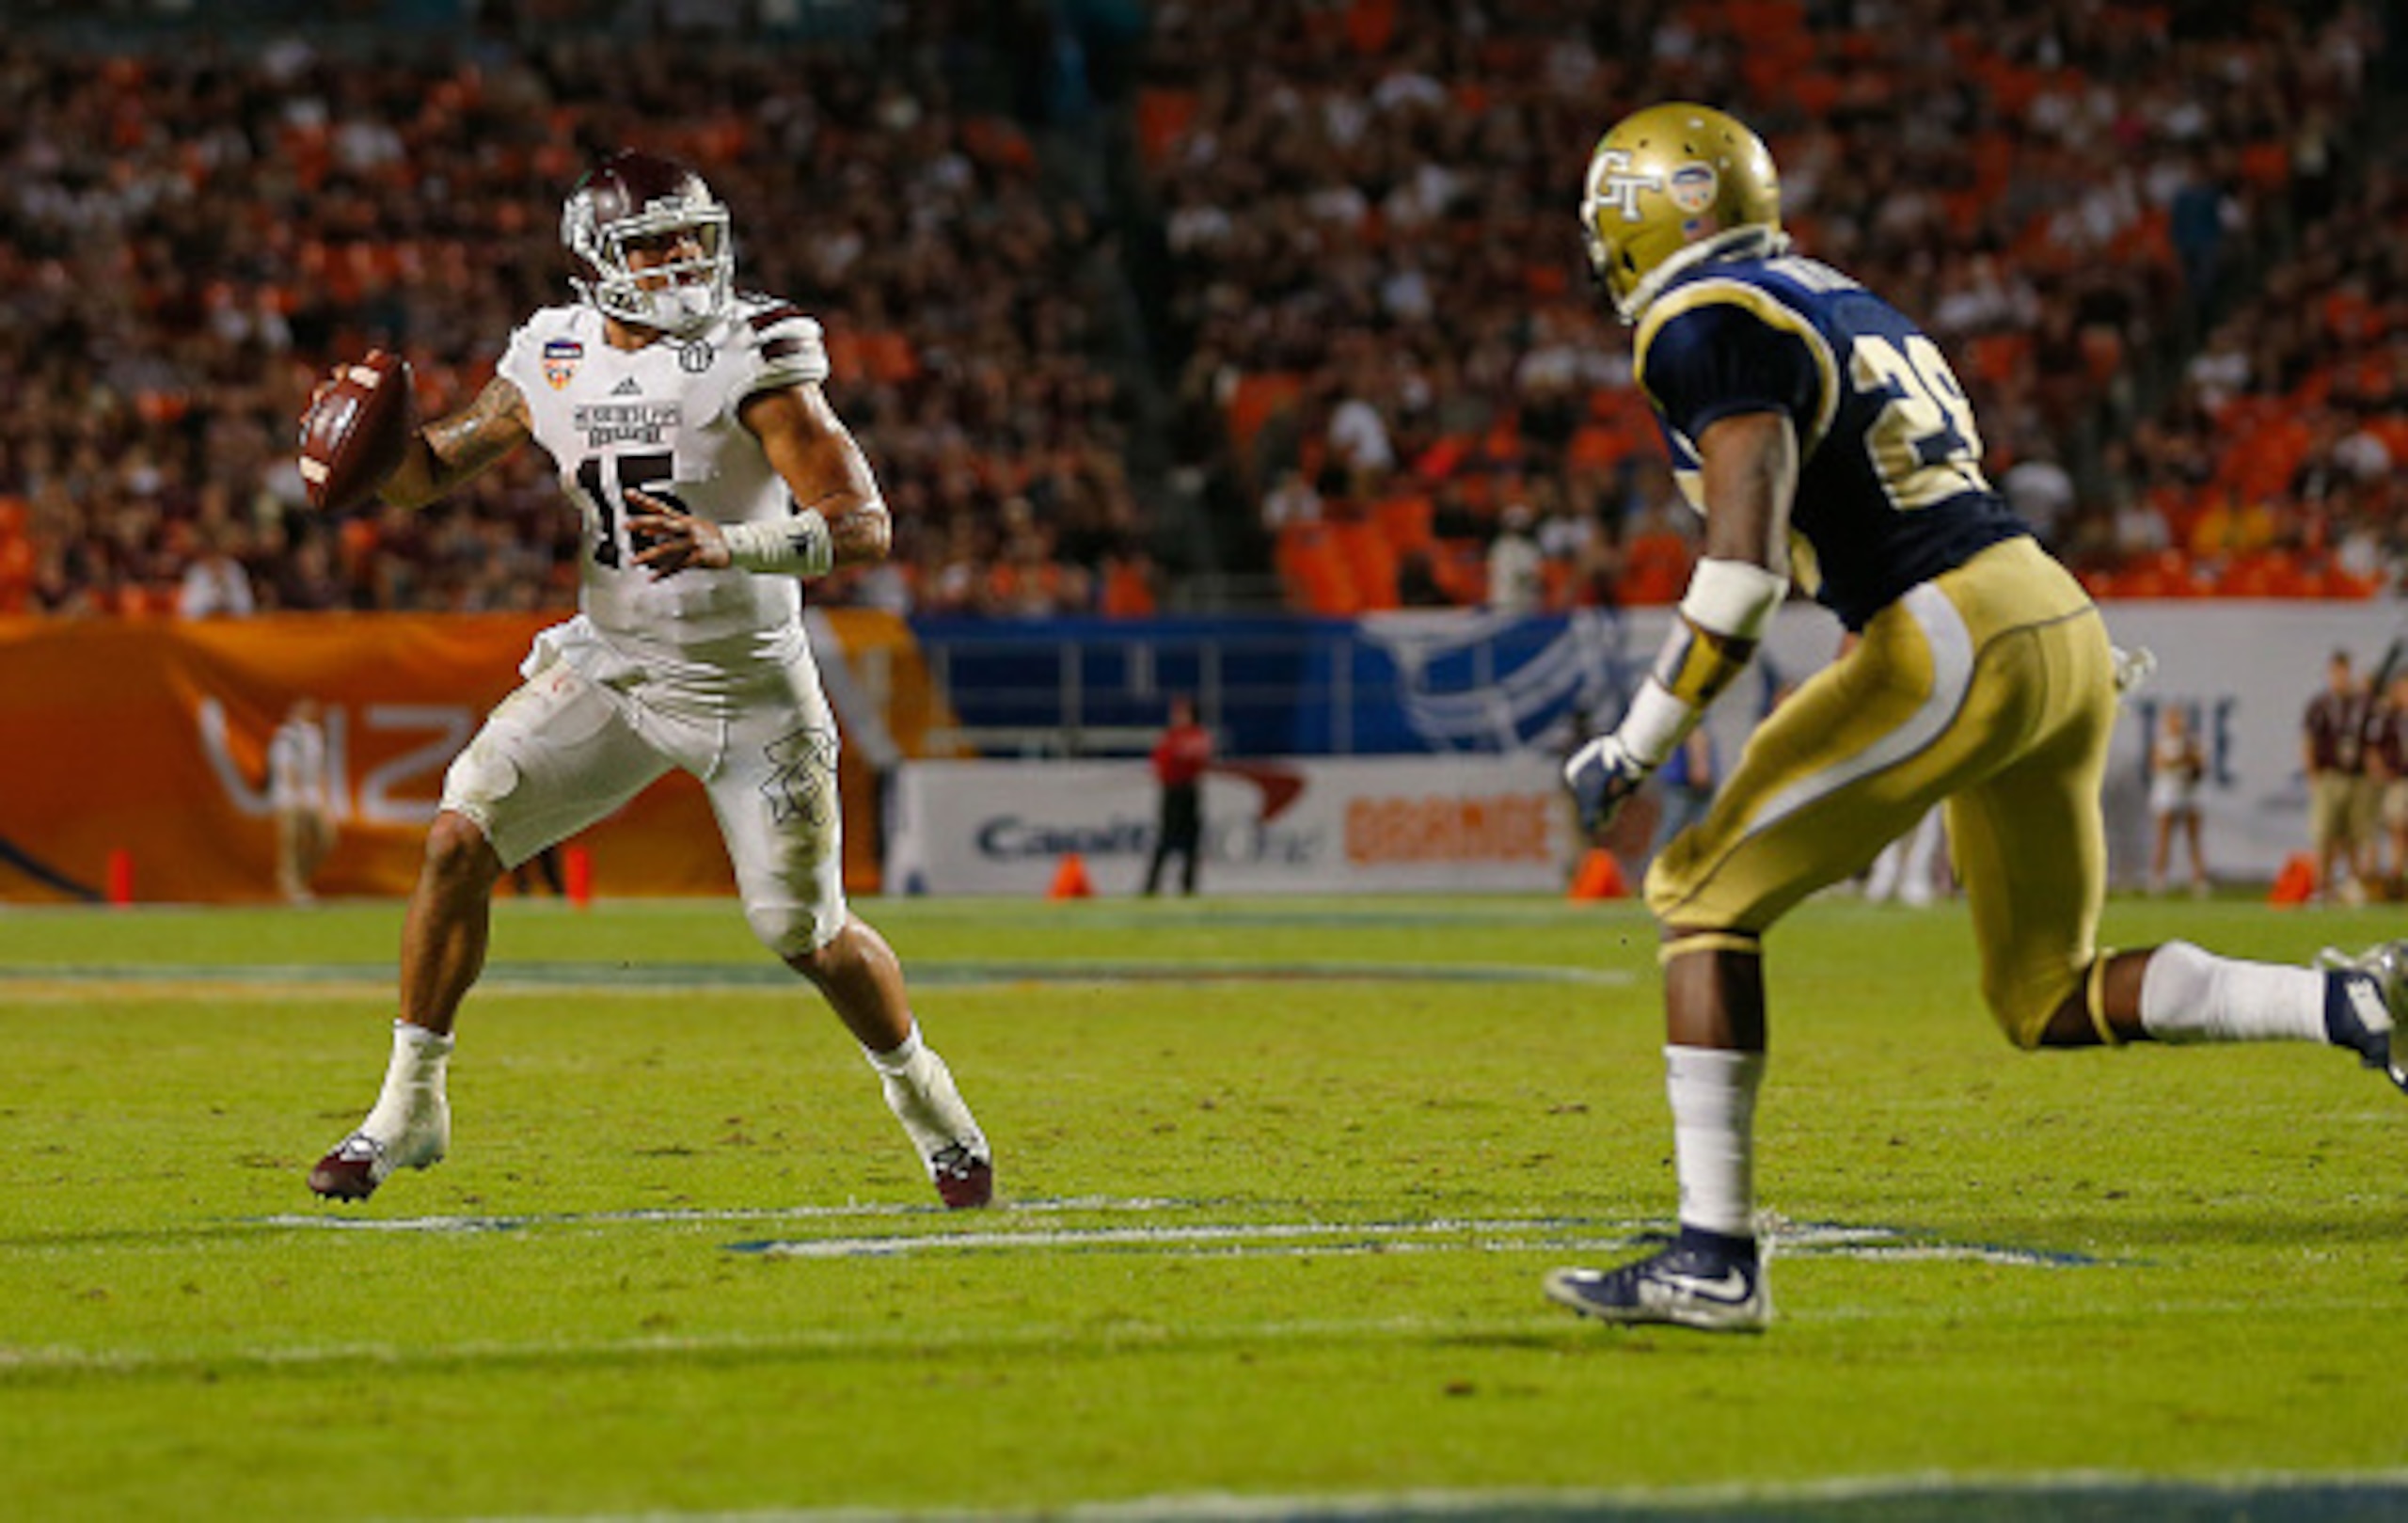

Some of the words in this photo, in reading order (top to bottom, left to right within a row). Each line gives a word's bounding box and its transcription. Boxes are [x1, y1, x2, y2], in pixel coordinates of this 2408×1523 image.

[1585, 151, 1662, 223] GT
[577, 452, 691, 570] 15
[974, 814, 1164, 862] Capit
